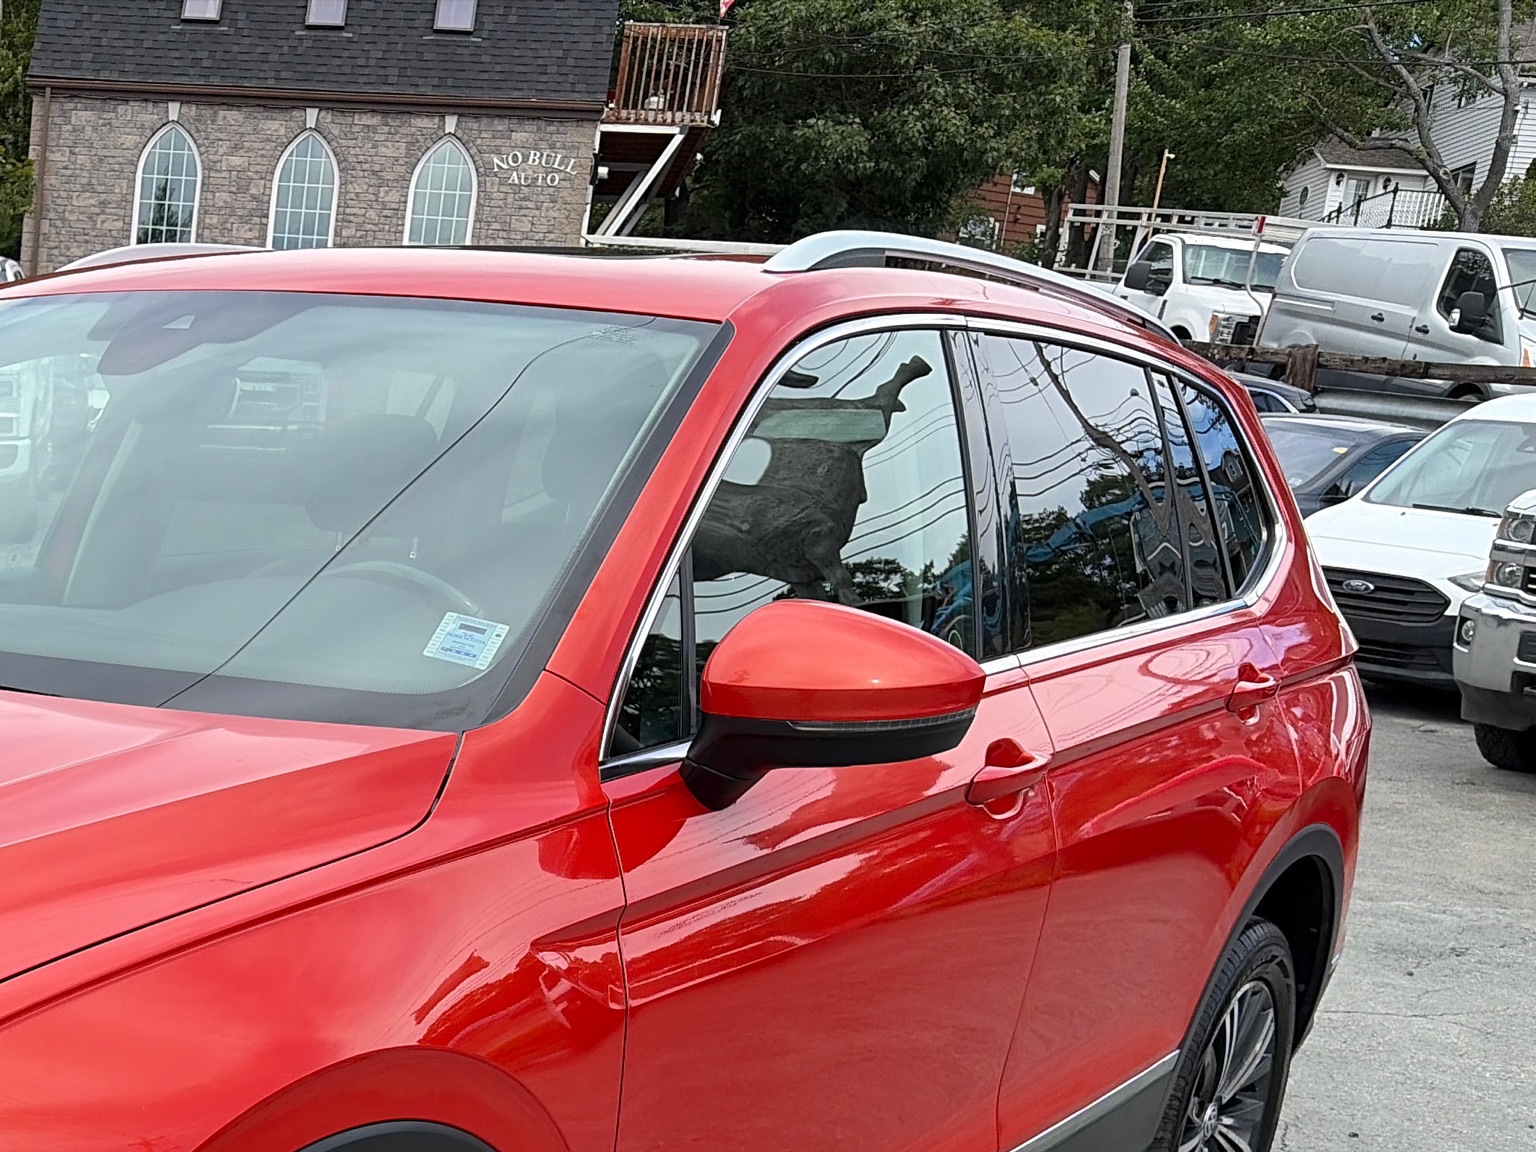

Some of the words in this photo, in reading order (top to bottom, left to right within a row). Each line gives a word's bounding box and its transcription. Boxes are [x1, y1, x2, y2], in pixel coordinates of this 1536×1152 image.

[492, 151, 522, 172] NO
[527, 151, 578, 175] BULL
[507, 171, 559, 186] AUTO
